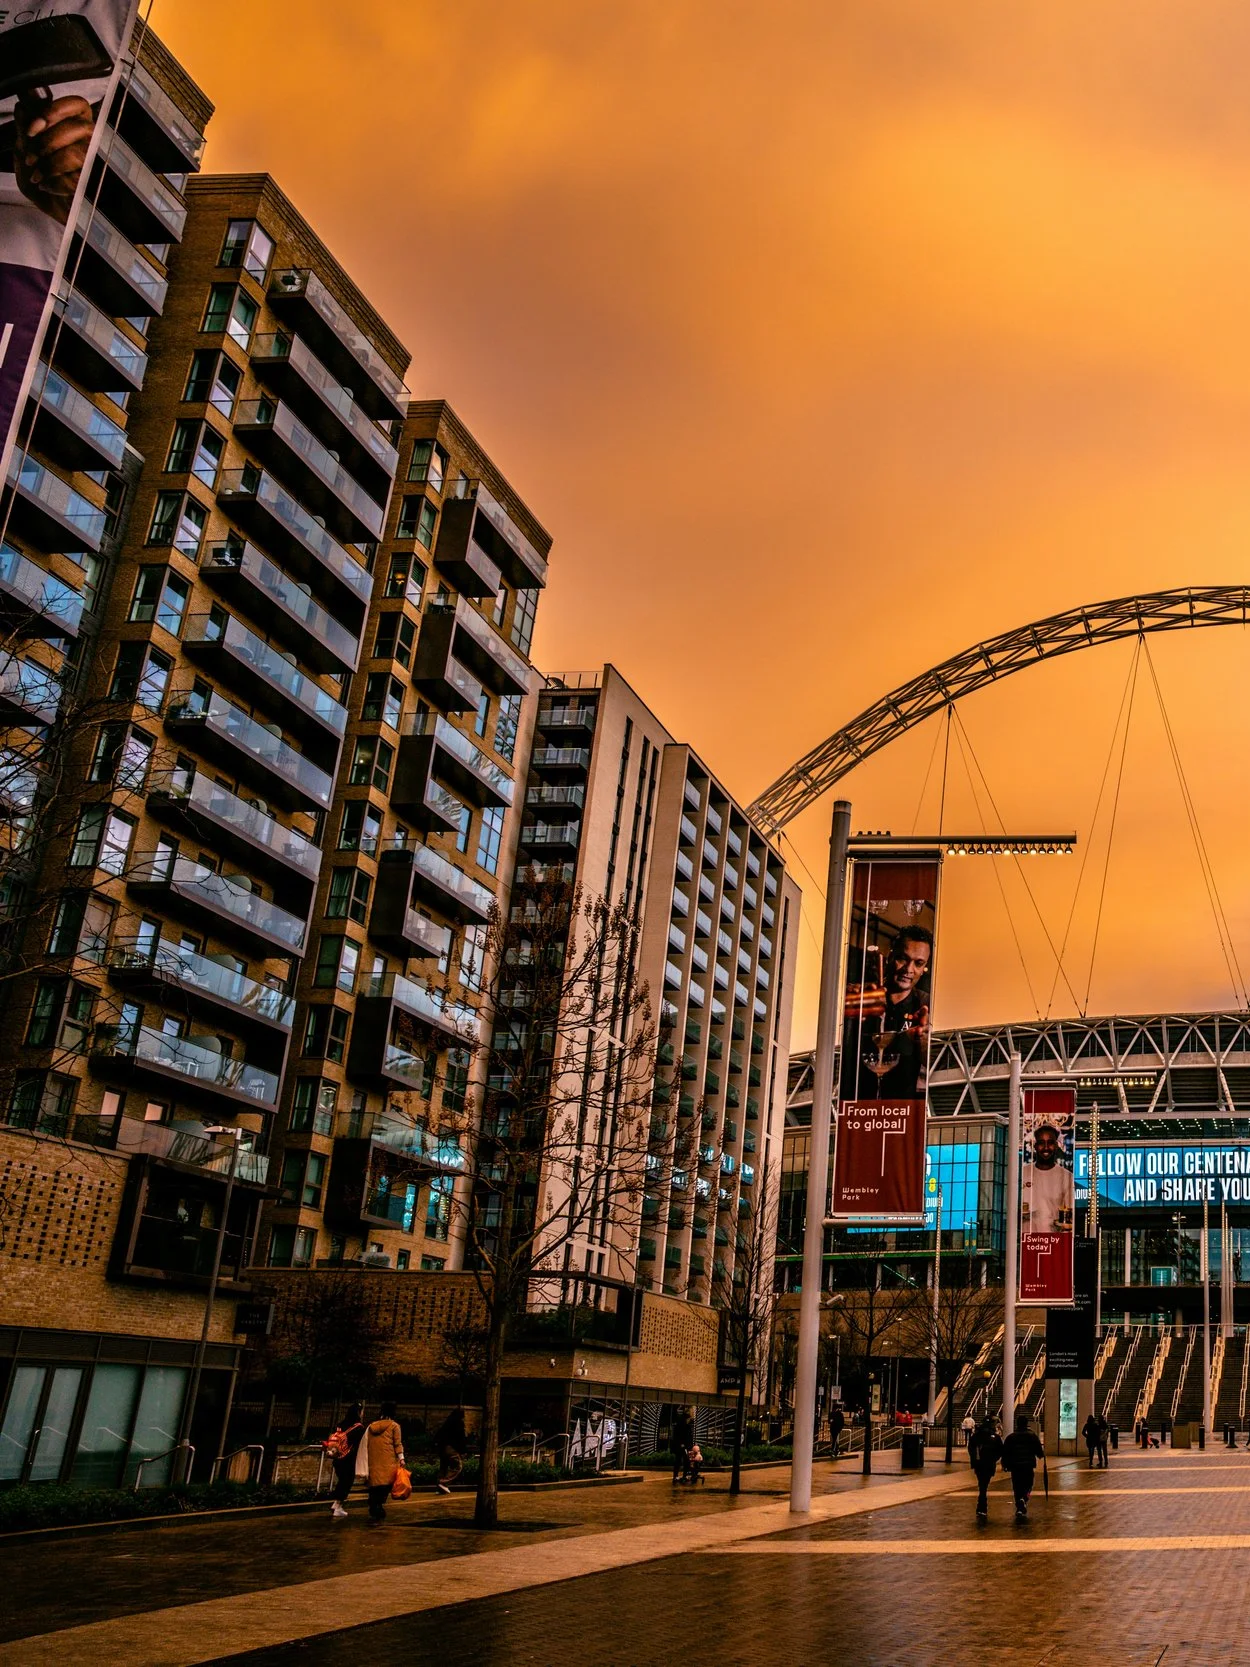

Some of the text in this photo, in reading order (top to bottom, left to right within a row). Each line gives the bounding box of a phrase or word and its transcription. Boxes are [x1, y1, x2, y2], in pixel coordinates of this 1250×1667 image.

[847, 1105, 910, 1116] From local
[847, 1118, 901, 1131] to global
[1147, 1152, 1179, 1175] OUR
[1123, 1178, 1157, 1202] AND
[1161, 1178, 1215, 1201] SHARE
[1026, 1235, 1060, 1244] Swing by
[1026, 1243, 1049, 1251] today
[569, 1417, 617, 1458] AMP
